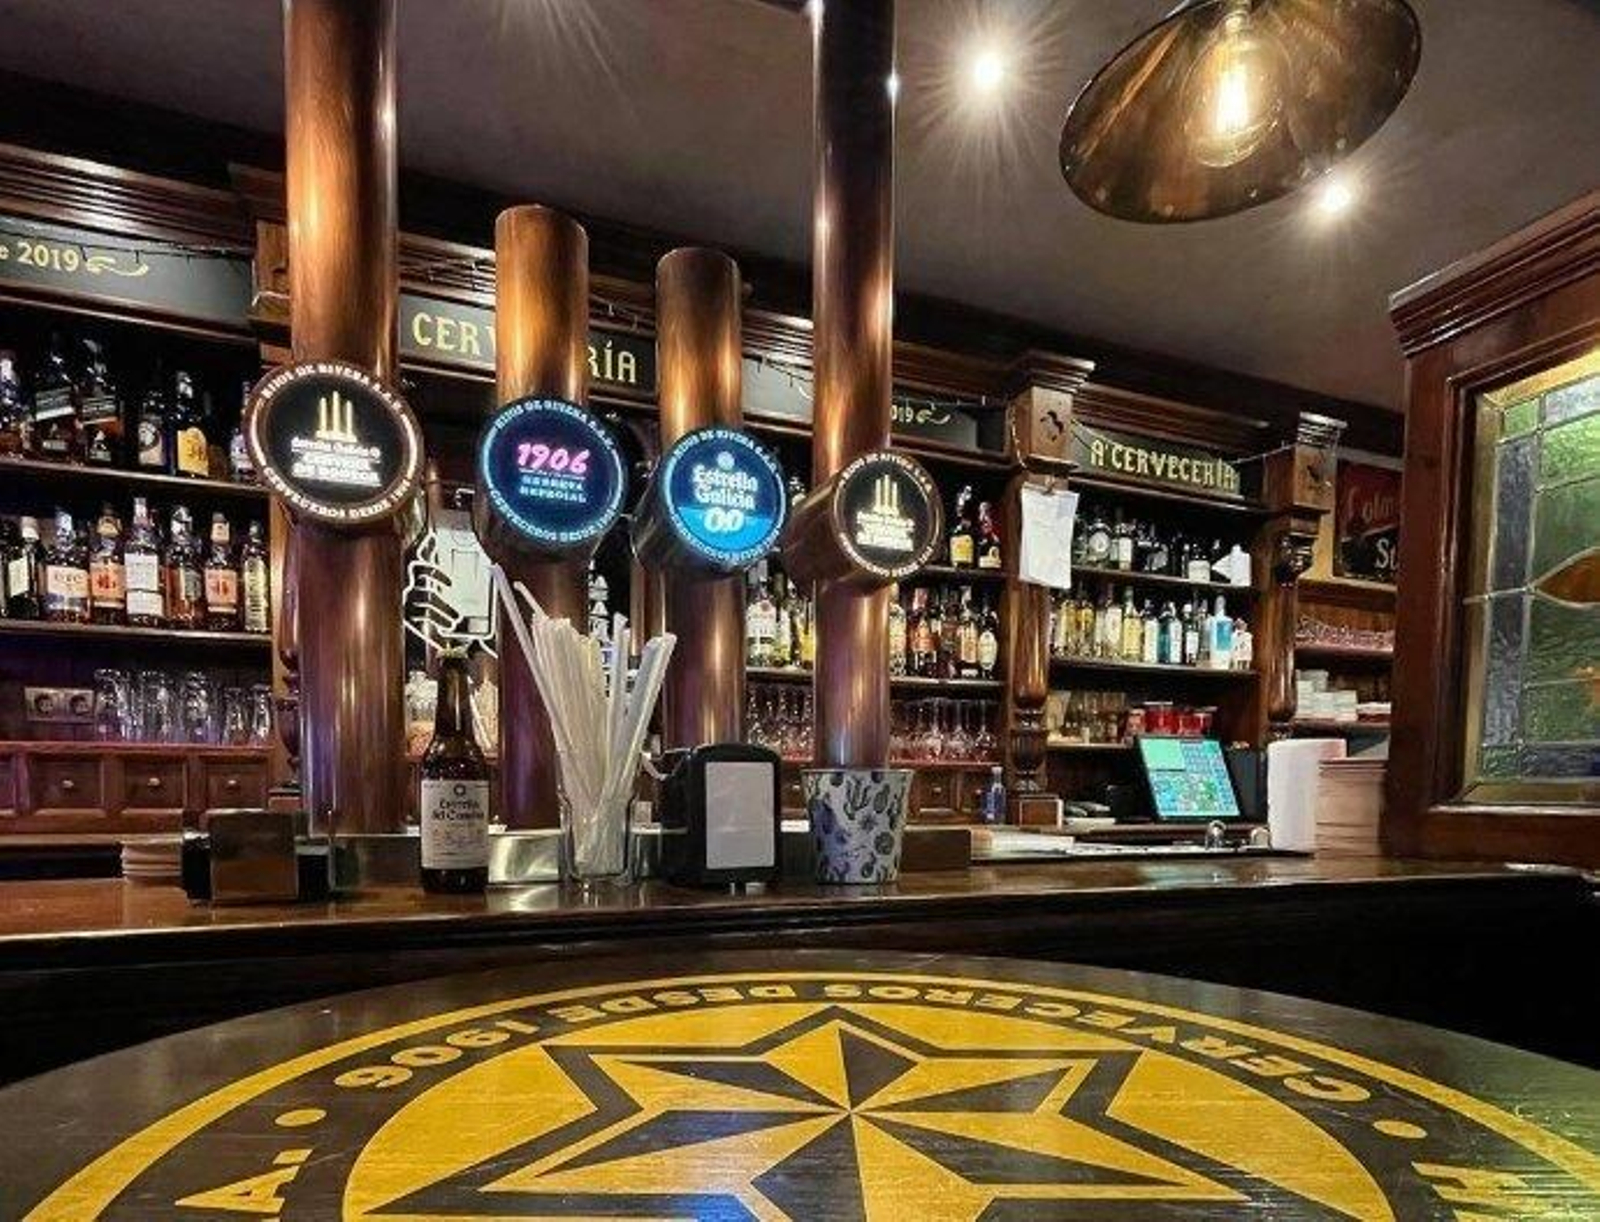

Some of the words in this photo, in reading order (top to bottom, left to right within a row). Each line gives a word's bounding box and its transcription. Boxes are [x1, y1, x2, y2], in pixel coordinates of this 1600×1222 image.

[17, 241, 79, 272] 2019
[517, 443, 590, 473] 1906
[546, 984, 798, 1024] DESDE
[333, 1019, 539, 1089] 1906
[824, 984, 1371, 1103] CERVECEROS
